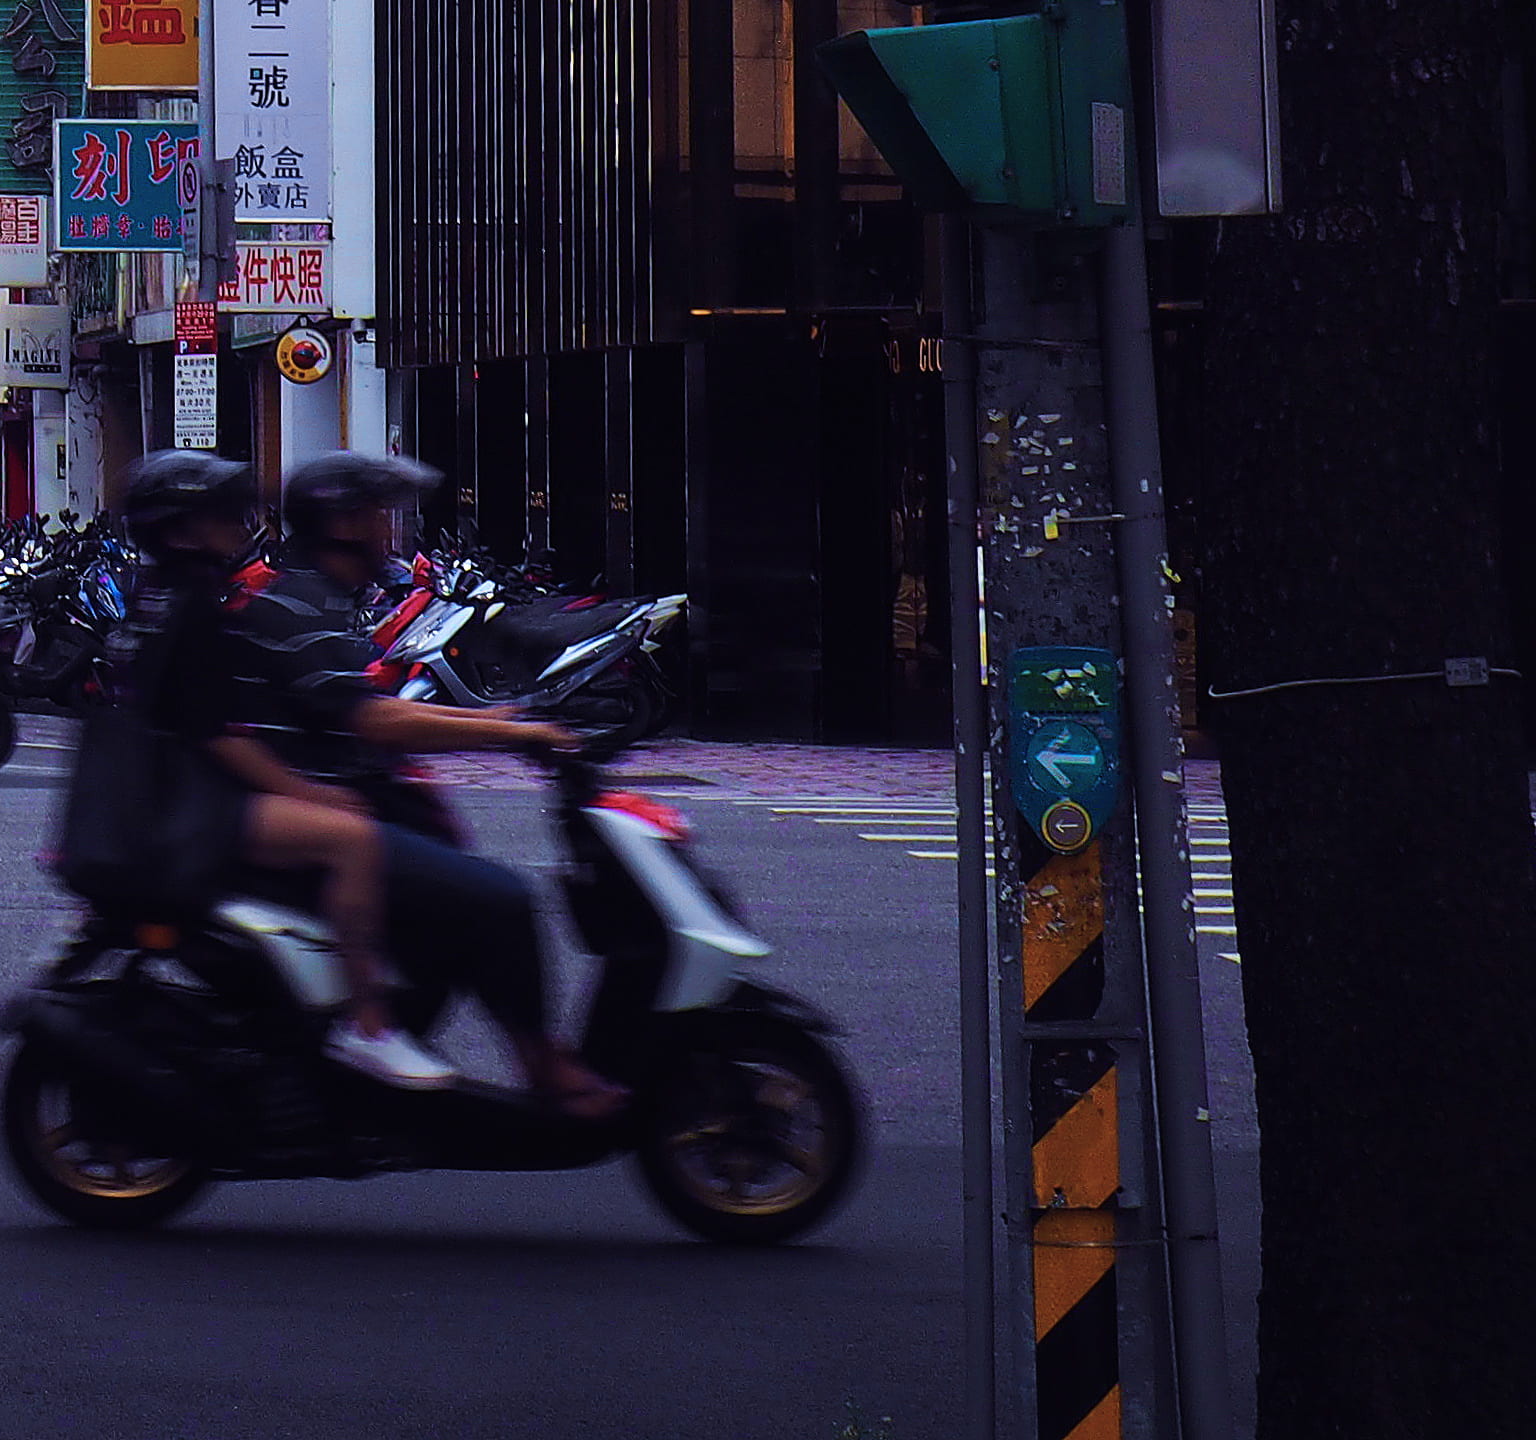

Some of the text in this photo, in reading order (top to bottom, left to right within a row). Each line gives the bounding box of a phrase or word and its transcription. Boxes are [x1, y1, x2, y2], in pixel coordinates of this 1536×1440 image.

[235, 144, 305, 181] 飯盒
[234, 183, 309, 211] 外賣店
[179, 340, 188, 353] P
